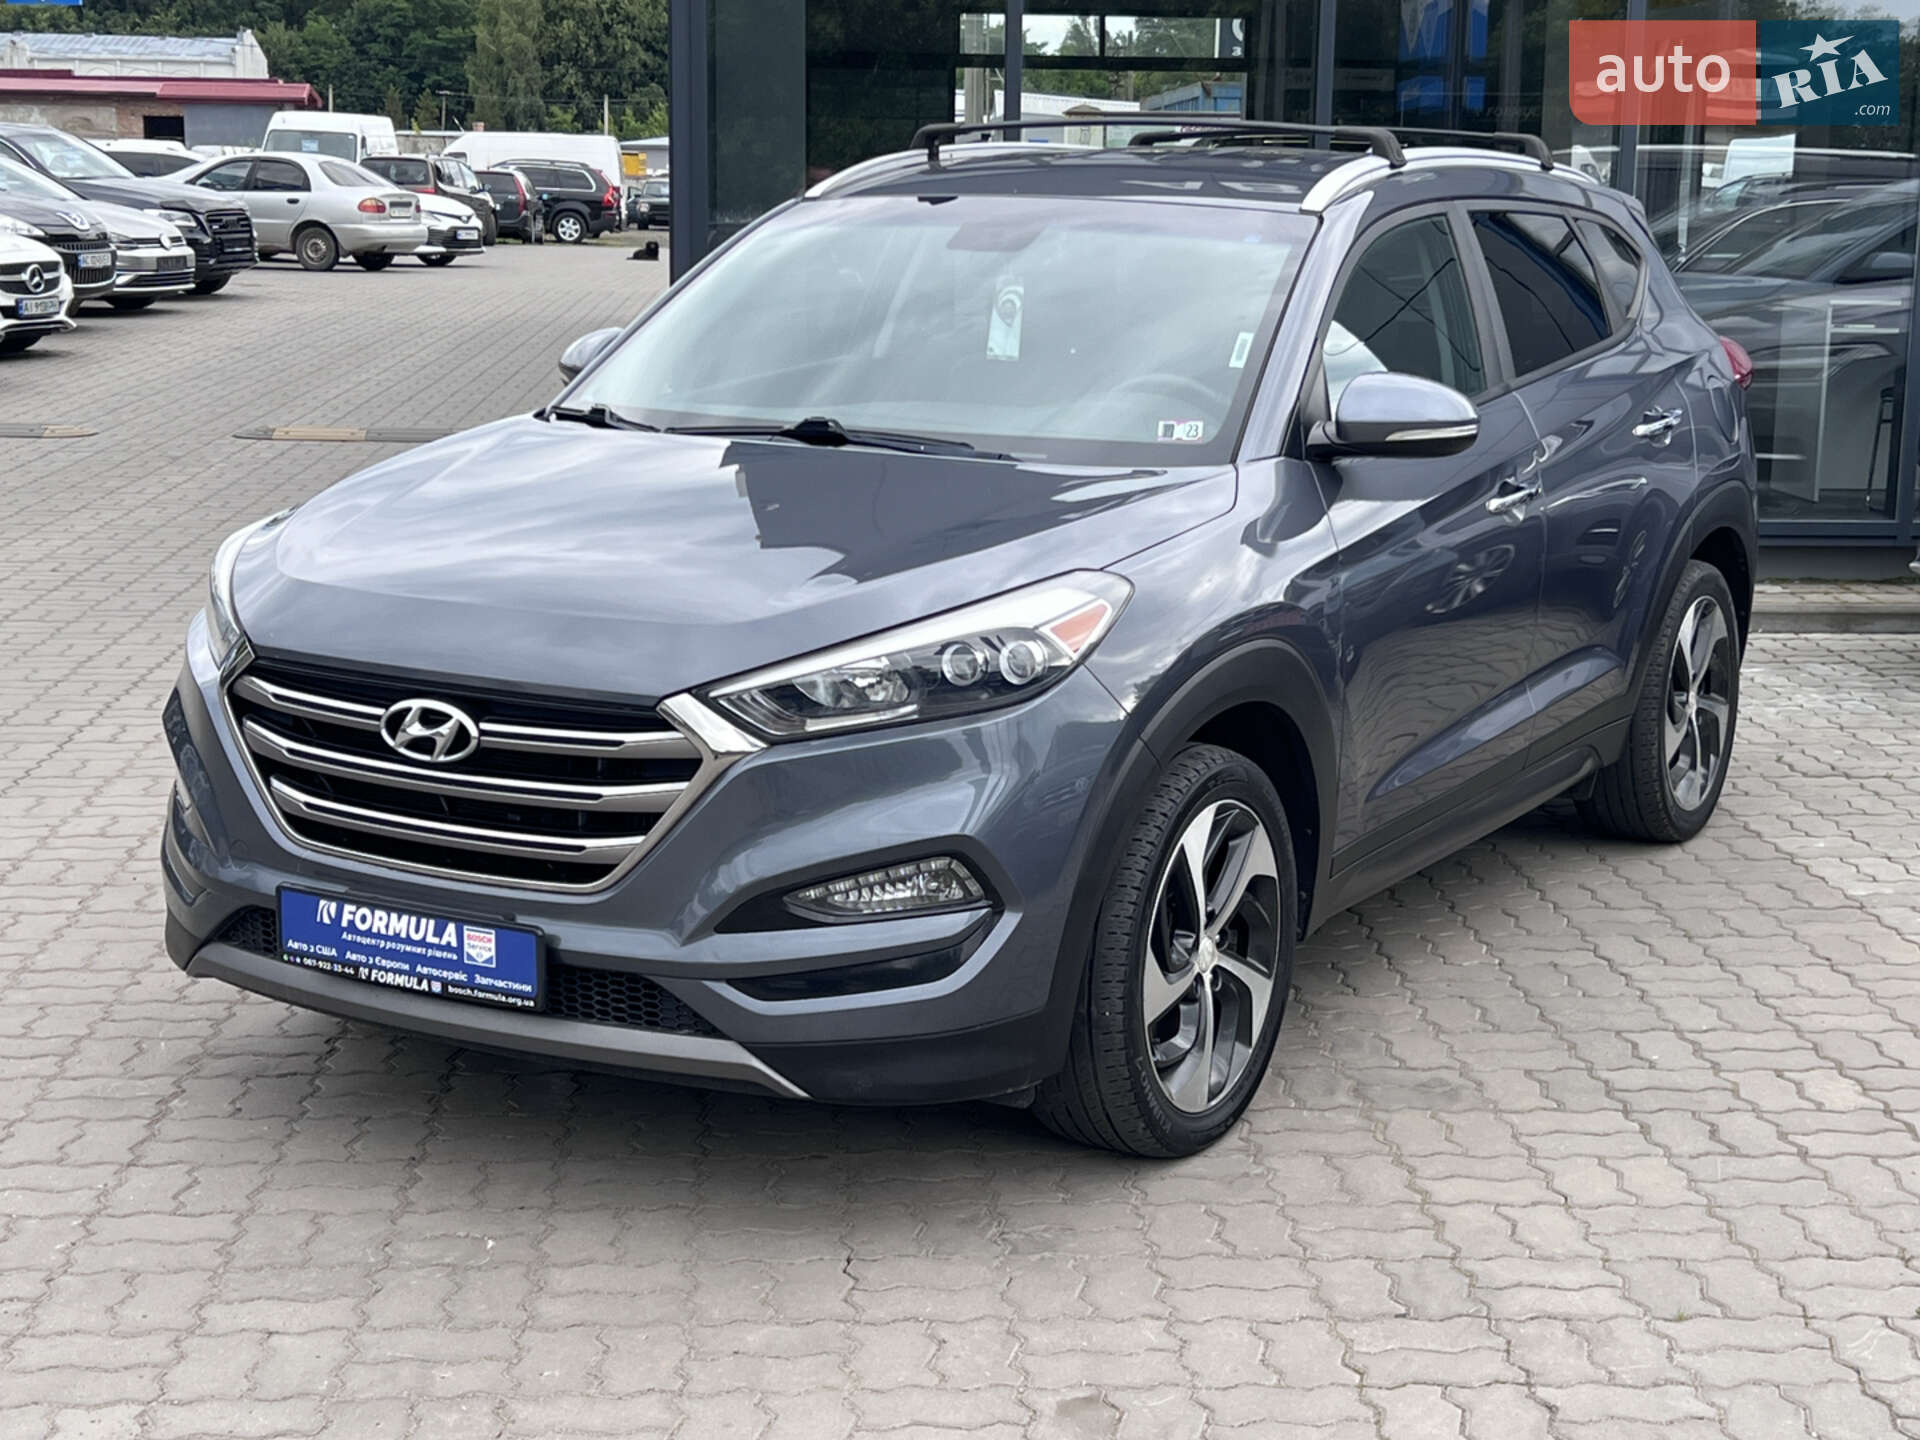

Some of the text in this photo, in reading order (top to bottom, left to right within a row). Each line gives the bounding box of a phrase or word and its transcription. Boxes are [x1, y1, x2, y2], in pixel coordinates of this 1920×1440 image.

[1186, 423, 1199, 438] 23
[341, 903, 458, 948] FORMULA
[341, 931, 458, 960] Автоцентр розумних рішень
[467, 933, 492, 944] BOSCH
[467, 942, 492, 952] Service
[287, 939, 338, 957] Авто з США
[345, 950, 410, 970] Авто з Європи
[370, 968, 429, 991] FORMULA
[416, 963, 468, 981] Автосервіс
[474, 974, 533, 992] Запчастини
[448, 985, 535, 1007] bosch.formula.org.ua
